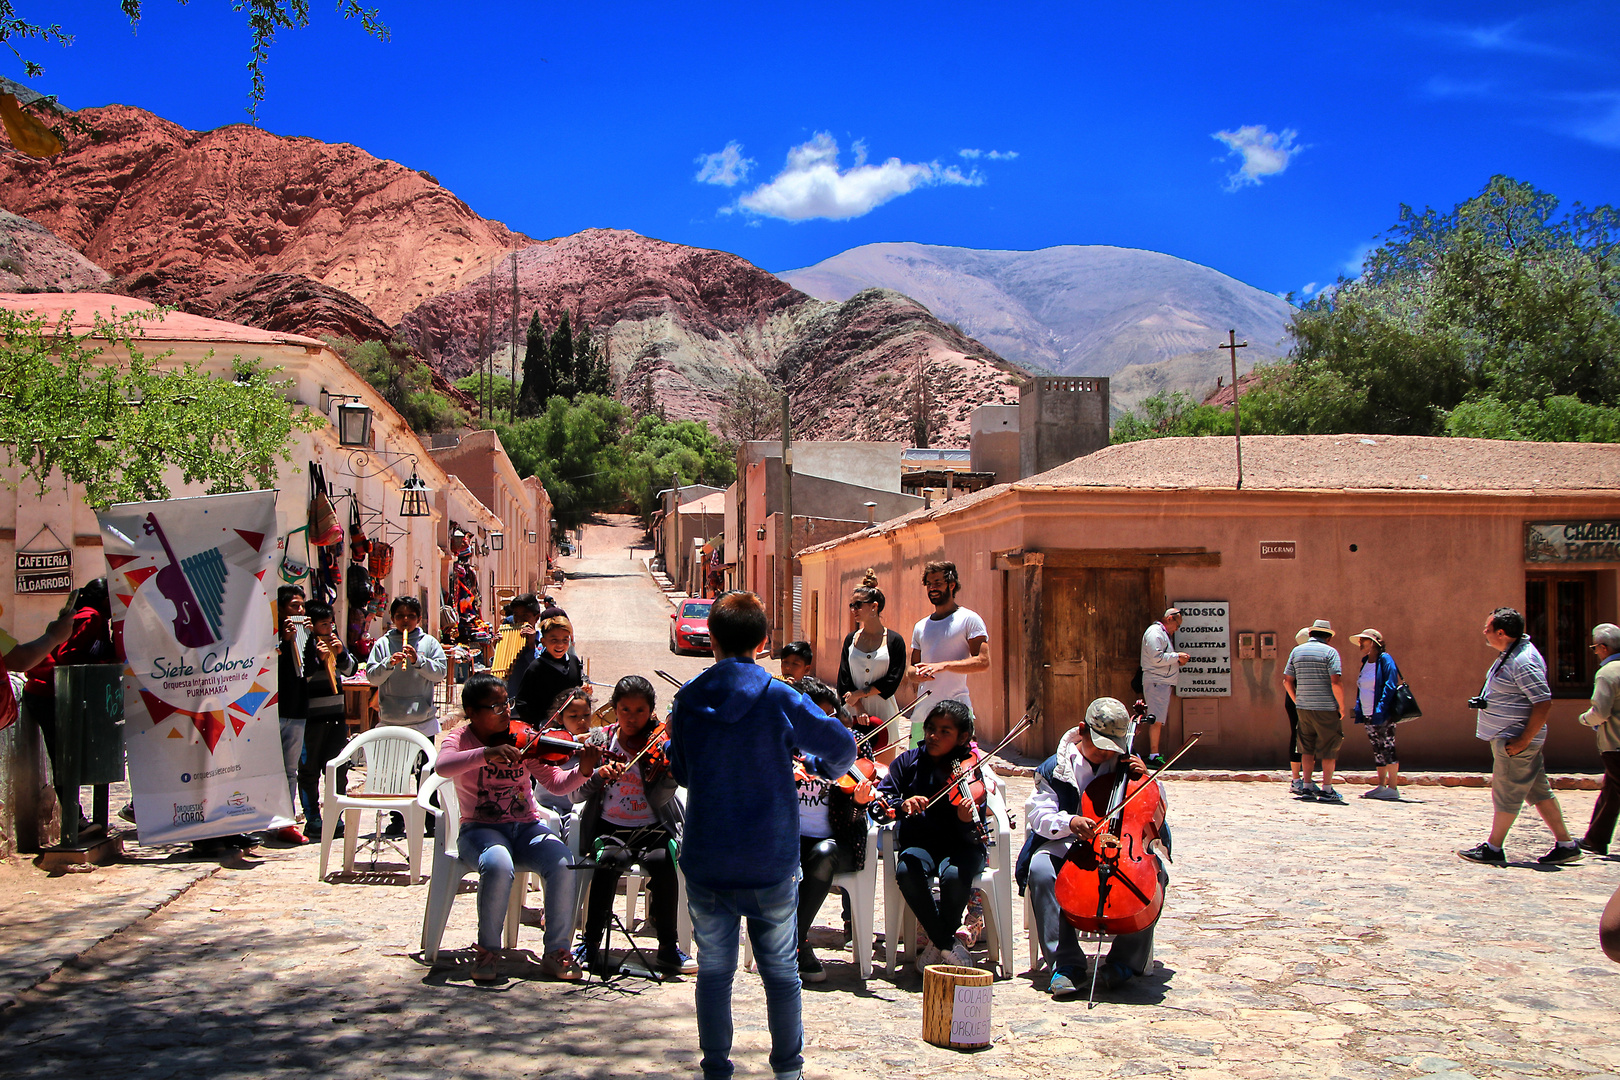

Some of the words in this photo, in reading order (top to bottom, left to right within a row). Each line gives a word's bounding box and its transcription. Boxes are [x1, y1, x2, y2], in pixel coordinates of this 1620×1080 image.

[1262, 546, 1294, 554] BELGRANO
[18, 576, 70, 592] ALGARROBO
[1180, 608, 1225, 616] KIOSKO
[151, 656, 193, 679] Siete
[202, 647, 255, 674] Colores
[1207, 666, 1230, 674] FRÍAS
[163, 679, 192, 690] Orquesta
[193, 676, 216, 687] Infantil
[187, 685, 228, 698] PURMAMARCA
[484, 762, 524, 782] PARIS
[630, 800, 647, 811] The
[181, 811, 205, 823] COROS
[964, 1005, 981, 1018] CON
